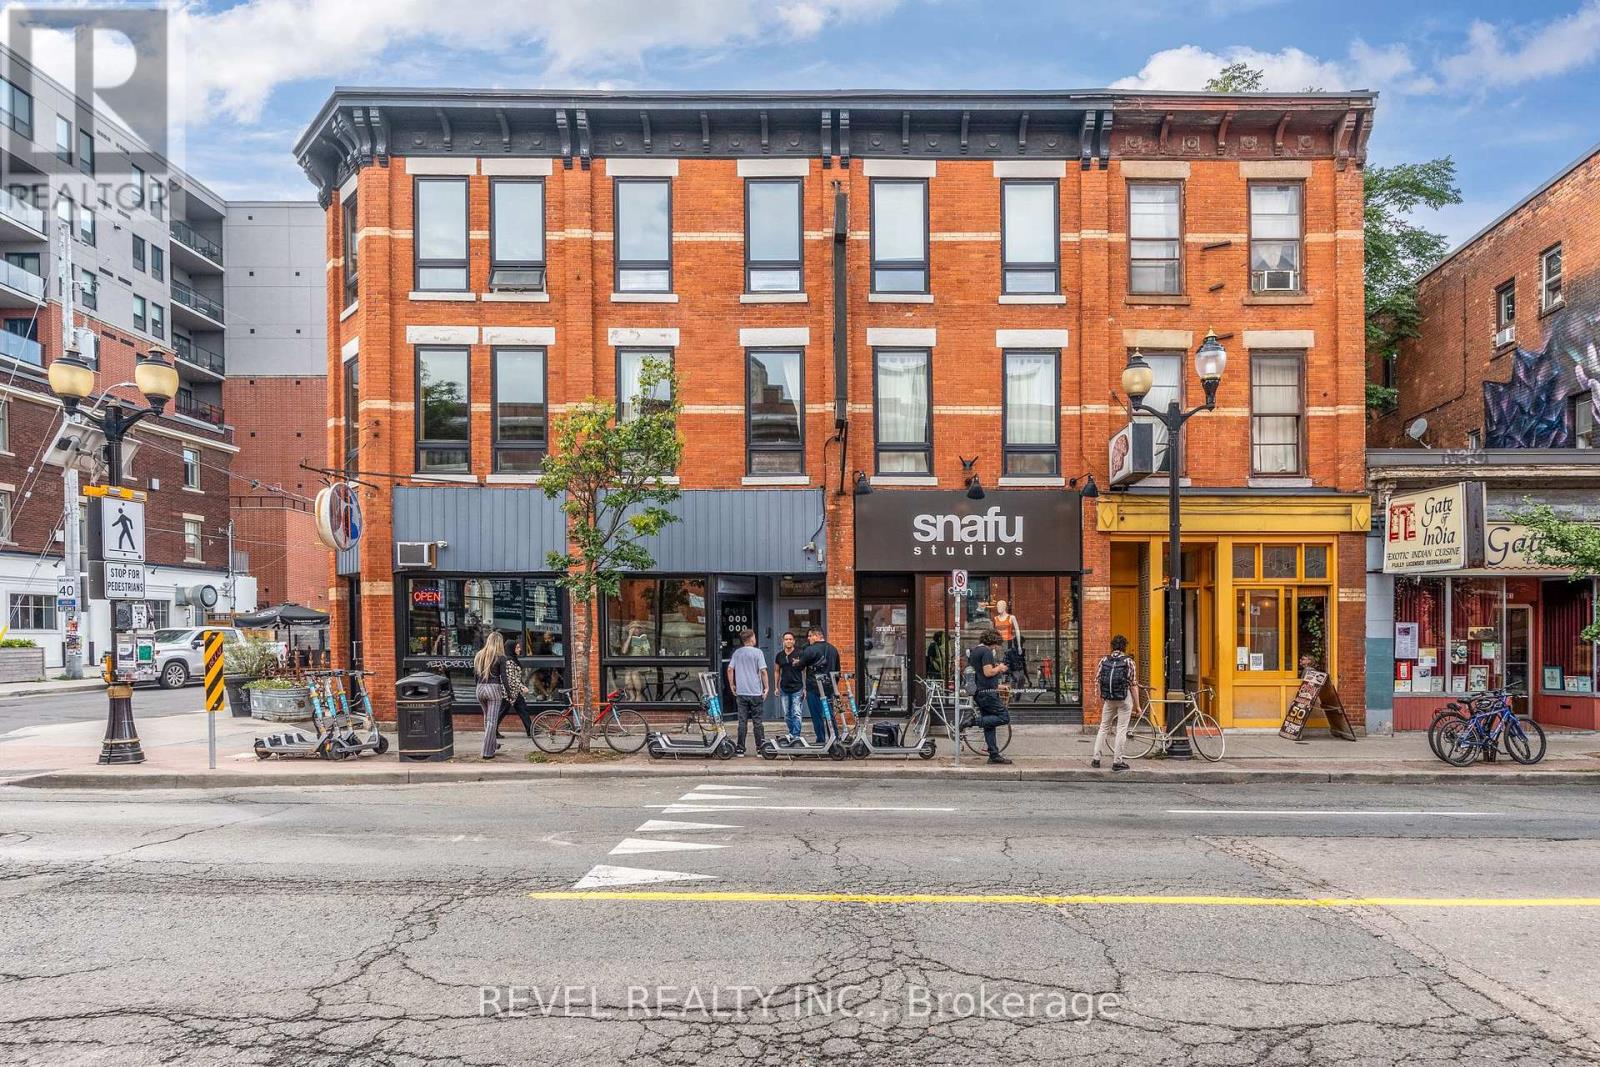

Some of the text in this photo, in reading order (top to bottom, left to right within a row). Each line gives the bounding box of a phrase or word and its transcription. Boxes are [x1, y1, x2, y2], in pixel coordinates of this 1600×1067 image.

[1421, 496, 1453, 528] Gate
[913, 506, 1024, 543] snafu
[1440, 512, 1450, 527] of
[1423, 525, 1456, 546] India
[913, 544, 1023, 556] studios
[1487, 526, 1546, 566] Gat
[1387, 546, 1461, 561] EXOTIC INDIAN CUISINE
[1426, 558, 1452, 566] RESTAURANT
[110, 568, 140, 579] STOP FOR
[59, 585, 74, 596] 40
[107, 581, 143, 592] PEDESTRIANS
[414, 592, 441, 602] OPEN
